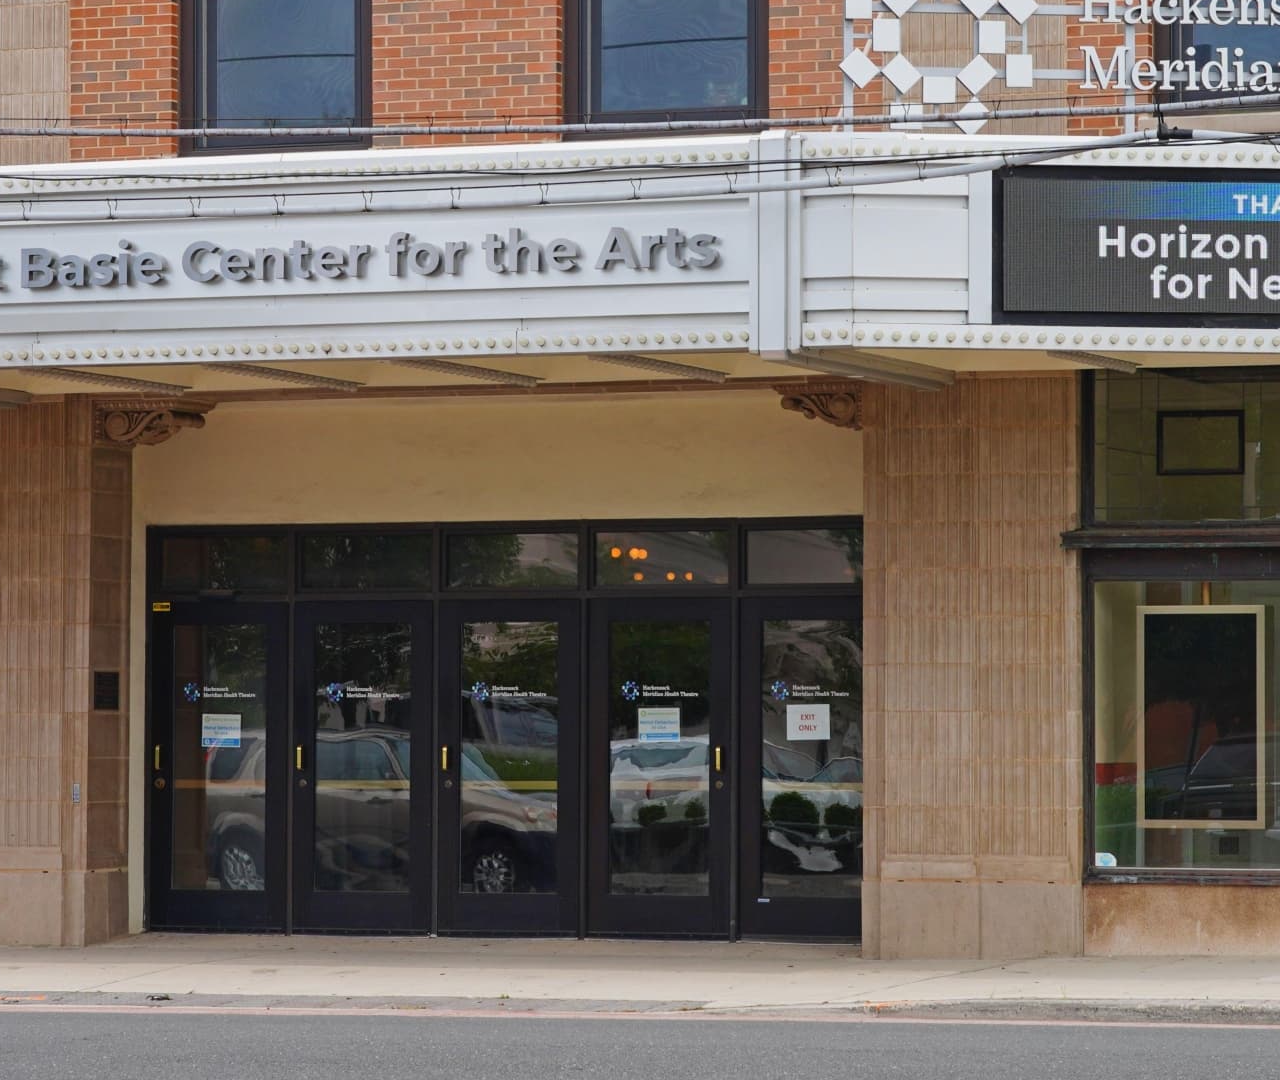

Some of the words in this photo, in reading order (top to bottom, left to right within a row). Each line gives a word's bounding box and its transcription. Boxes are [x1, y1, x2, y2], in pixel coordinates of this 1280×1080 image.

[19, 240, 167, 291] Basie
[181, 239, 372, 283] Center
[385, 232, 468, 278] for
[480, 227, 580, 275] the
[593, 226, 722, 272] Arts
[1097, 224, 1269, 261] Horizon
[1149, 264, 1213, 301] for
[798, 724, 817, 732] ONLY
